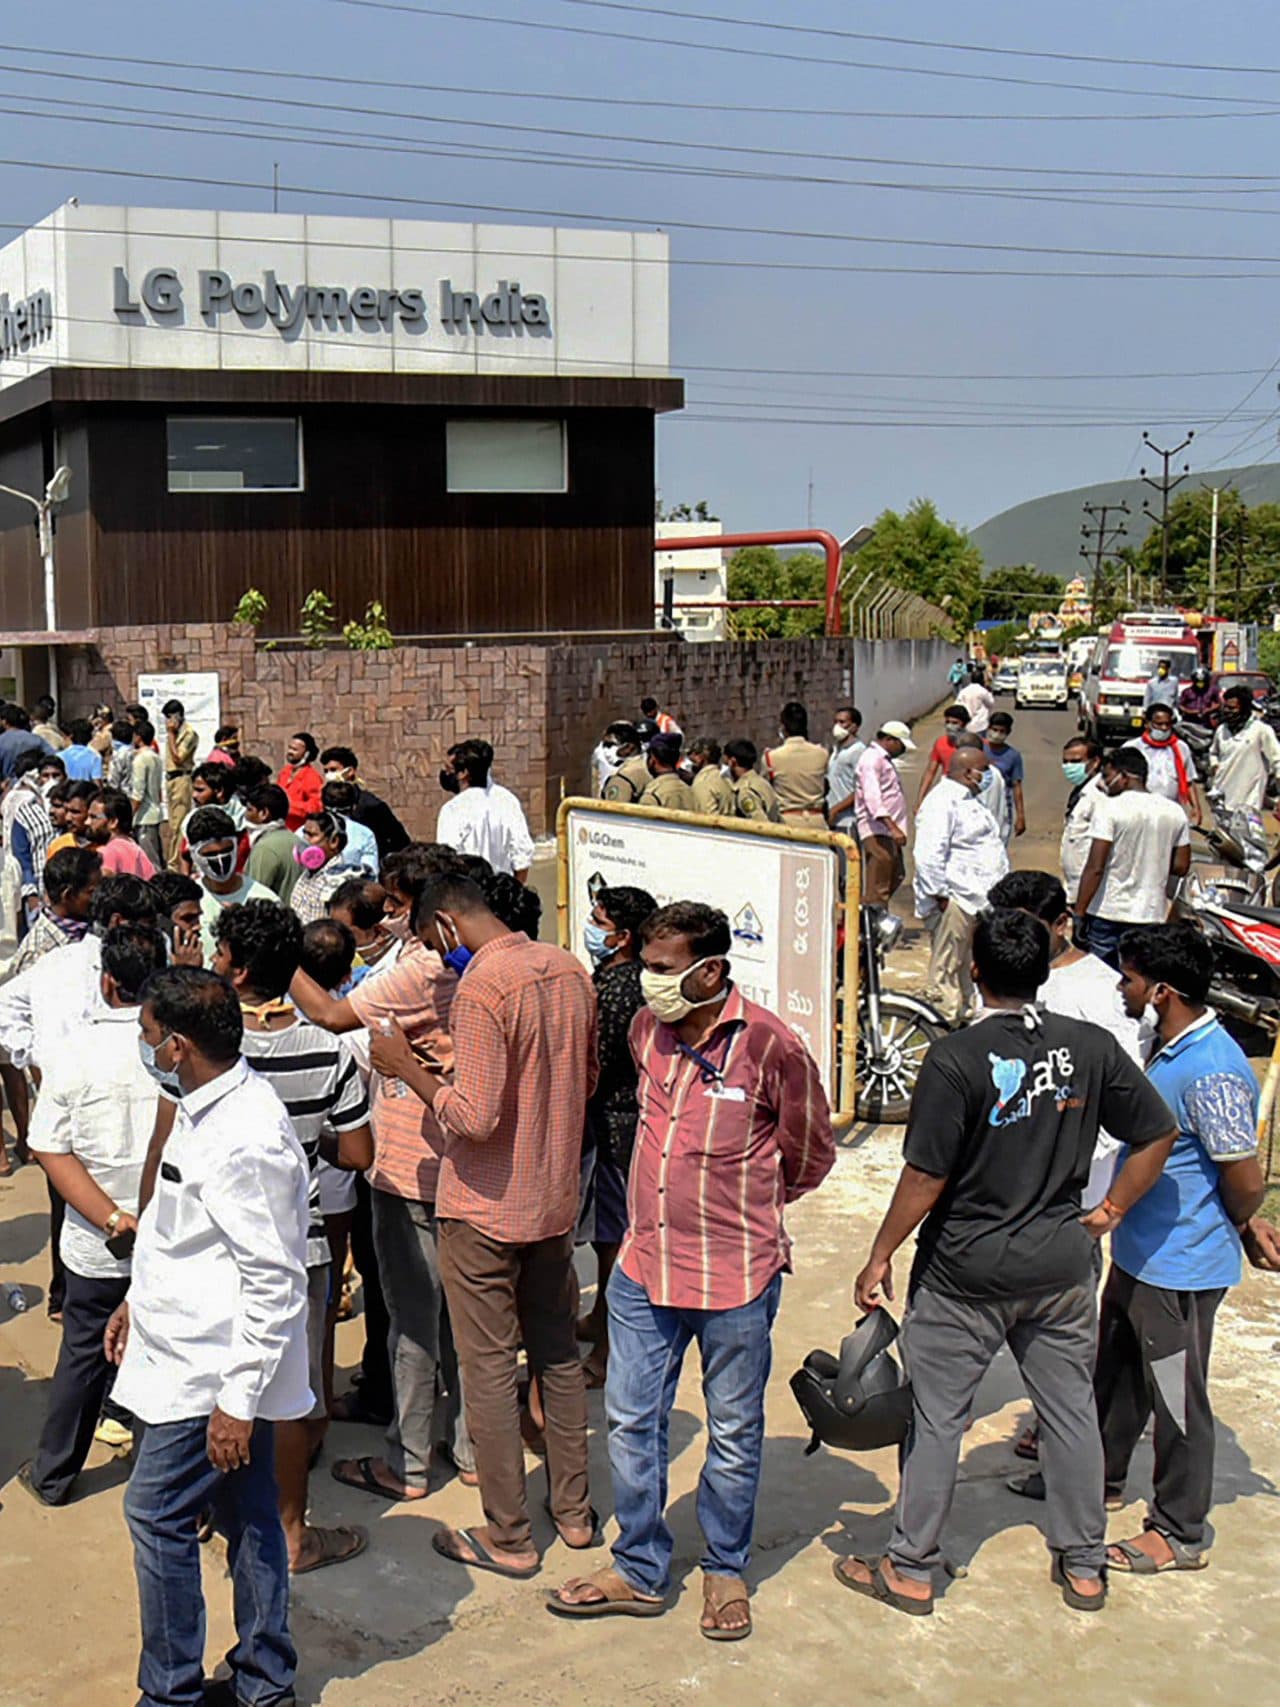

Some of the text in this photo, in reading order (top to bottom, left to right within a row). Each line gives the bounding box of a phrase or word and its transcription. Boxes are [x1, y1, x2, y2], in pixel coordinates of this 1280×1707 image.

[113, 266, 549, 336] LG Polymers India
